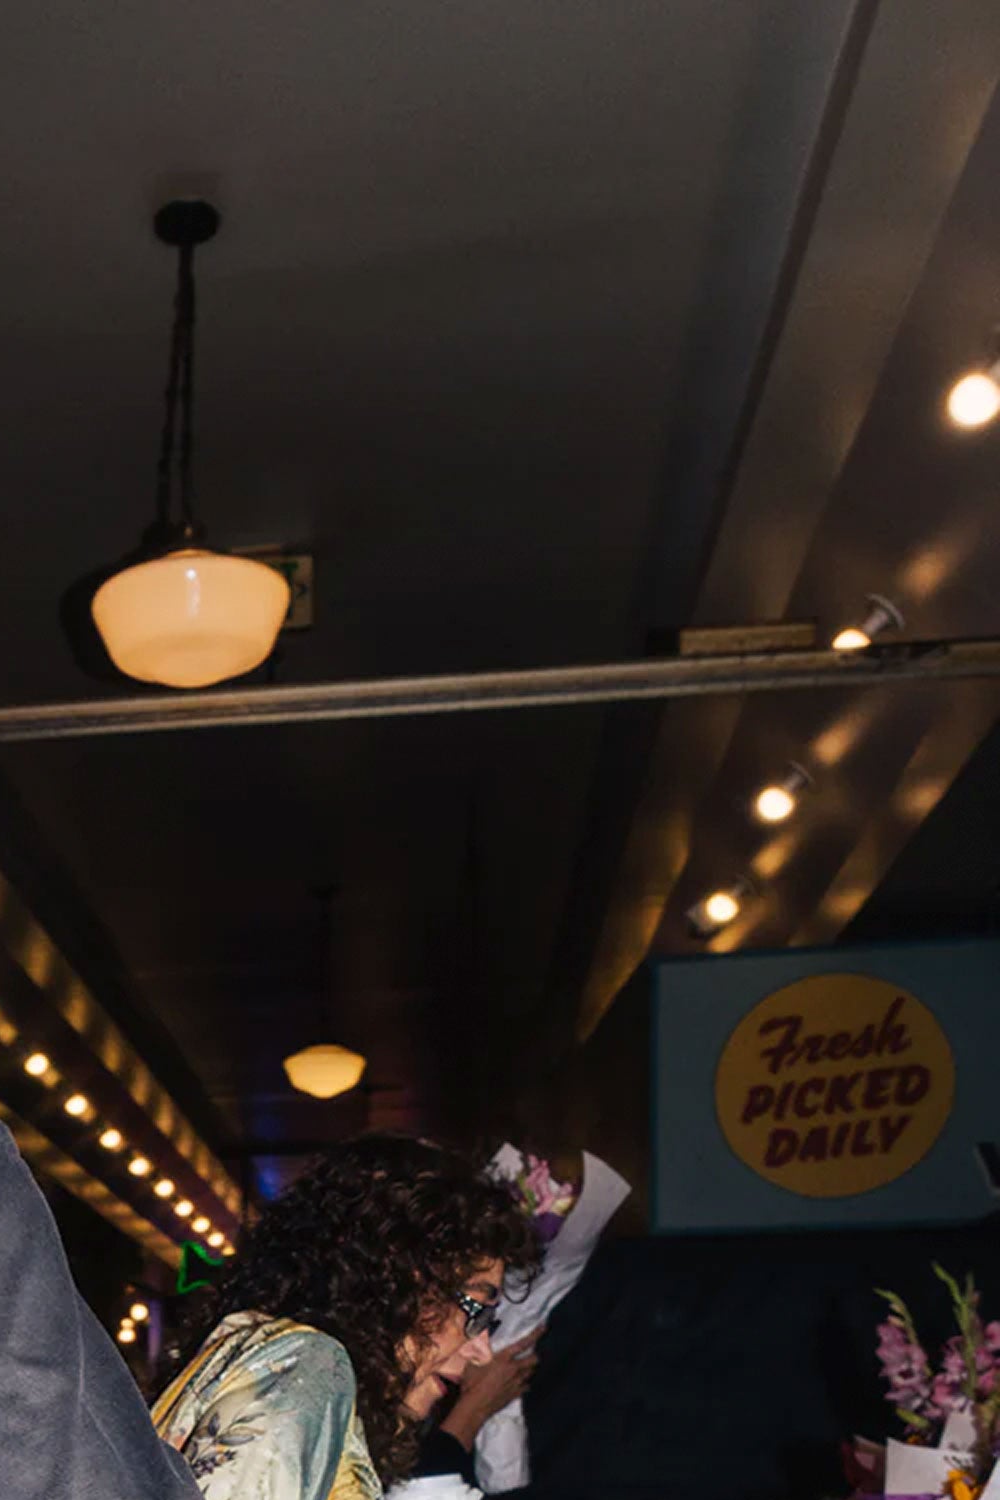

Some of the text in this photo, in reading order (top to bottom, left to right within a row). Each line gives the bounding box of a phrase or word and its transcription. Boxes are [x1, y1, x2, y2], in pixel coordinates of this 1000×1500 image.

[758, 996, 912, 1075] Fresh
[741, 1064, 932, 1124] PICKED
[764, 1115, 913, 1168] DAILY
